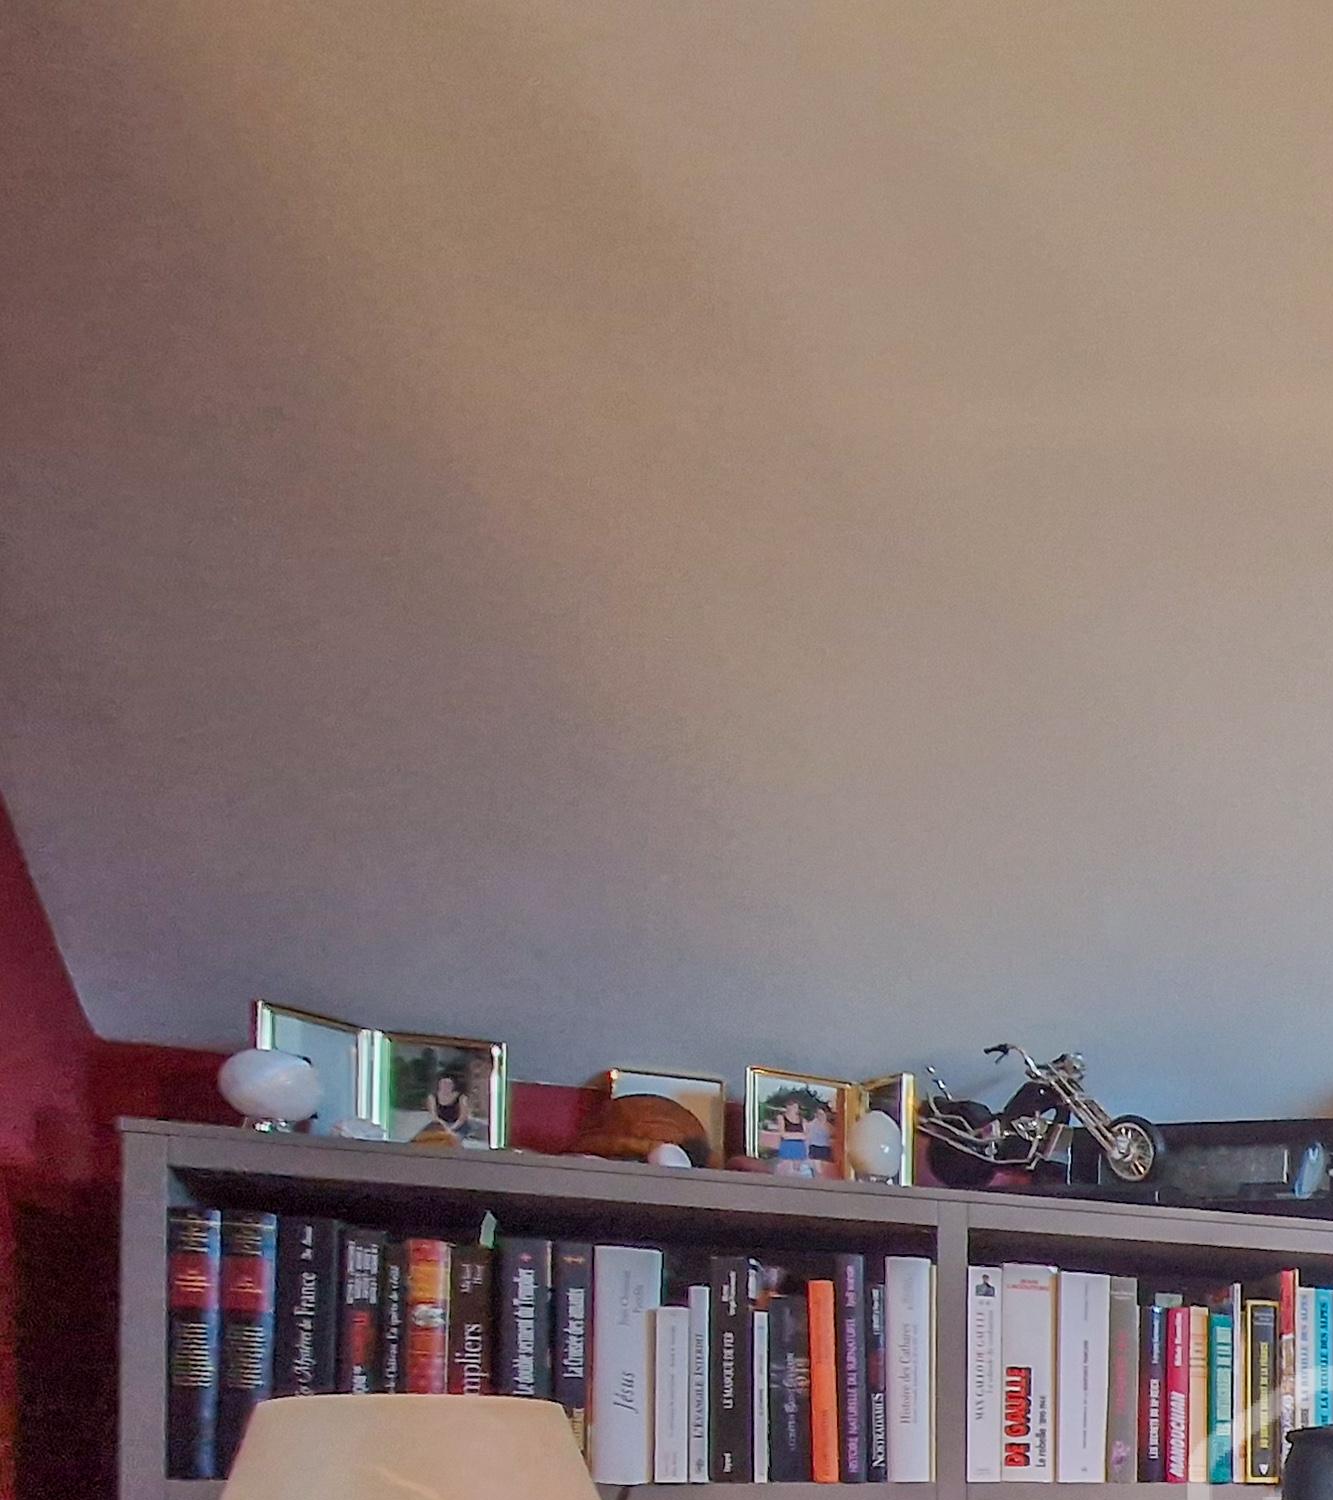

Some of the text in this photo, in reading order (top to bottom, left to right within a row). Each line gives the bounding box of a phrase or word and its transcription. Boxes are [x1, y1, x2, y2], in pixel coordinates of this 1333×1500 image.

[293, 1272, 318, 1316] France
[513, 1268, 538, 1304] Templier
[565, 1318, 584, 1334] des
[1298, 1295, 1308, 1322] ALPES
[514, 1320, 534, 1354] serment
[694, 1333, 704, 1376] INTERDIT
[722, 1332, 735, 1348] FER
[722, 1350, 735, 1361] DE
[1319, 1302, 1329, 1409] LA BATAILLE DES ALPES
[455, 1324, 489, 1395] mpliers
[512, 1356, 532, 1383] double
[564, 1367, 584, 1378] La
[722, 1363, 735, 1396] MASQUE
[899, 1324, 912, 1423] Histoire des Cathares
[975, 1312, 985, 1421] MAX GALLO DE GAULLE
[612, 1371, 639, 1414] Jésus
[846, 1319, 859, 1472] HISTOIRE NATURELLE DU SURNATUREL
[871, 1393, 885, 1467] NOSTRADAMUS
[1004, 1366, 1032, 1467] DE GAULLE
[1169, 1391, 1185, 1477] MANOUCHIAN
[1035, 1428, 1047, 1467] Le rebelle
